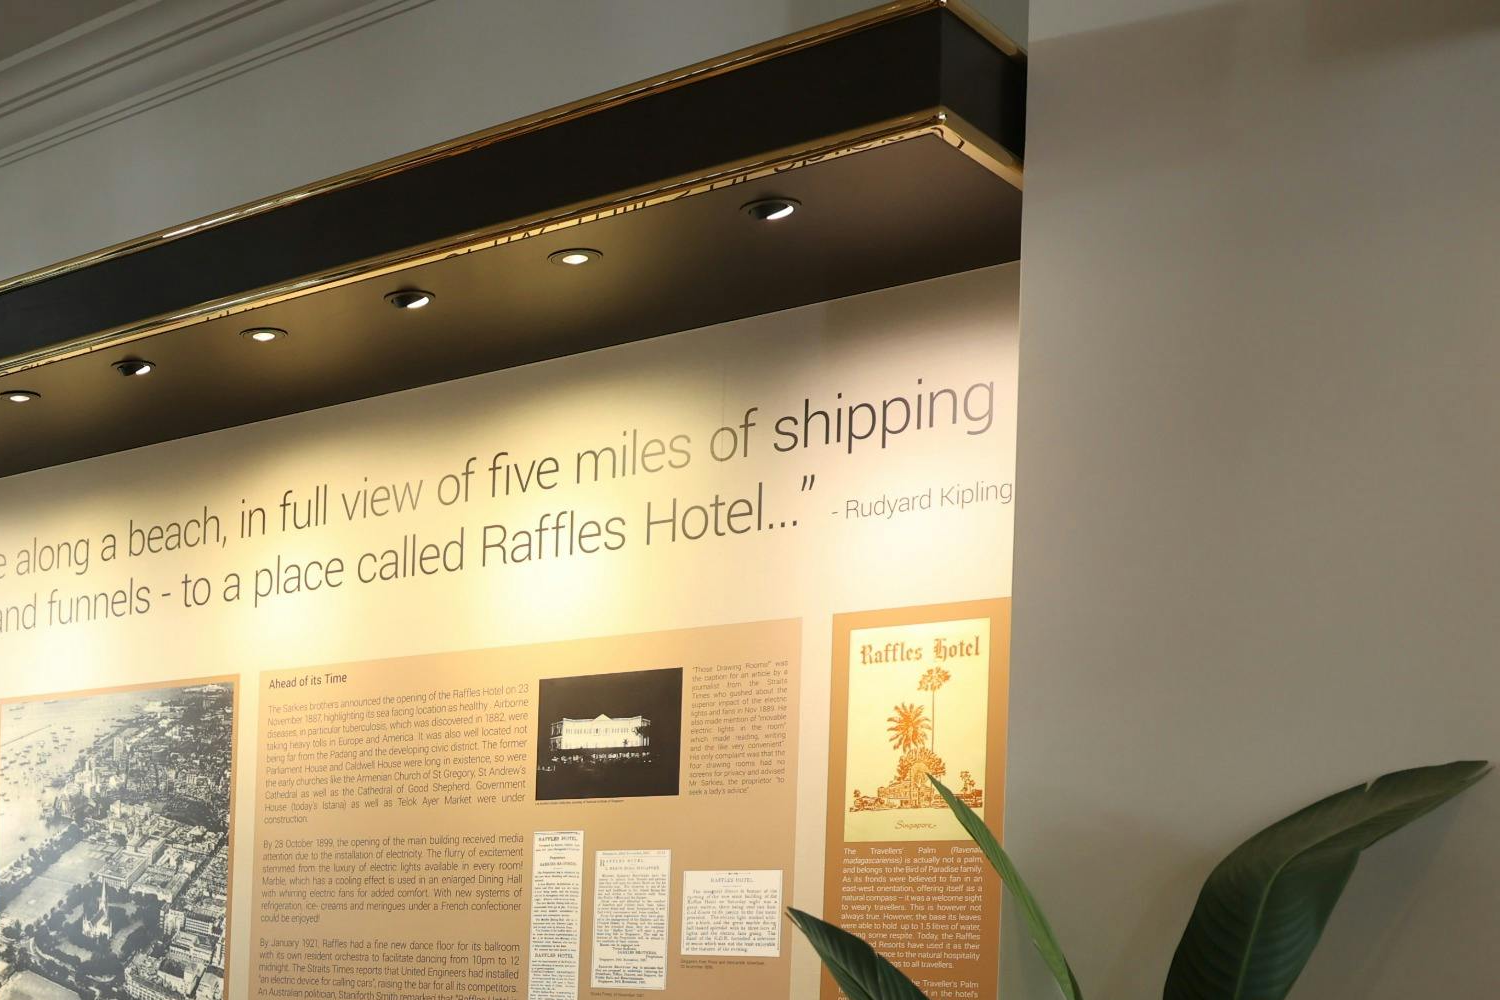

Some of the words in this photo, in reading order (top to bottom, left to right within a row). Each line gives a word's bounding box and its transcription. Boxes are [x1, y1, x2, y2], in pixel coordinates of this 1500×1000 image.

[16, 537, 90, 576] along
[101, 534, 116, 562] a
[129, 505, 227, 556] beach,
[241, 499, 266, 539] in
[280, 484, 328, 531] full
[342, 477, 424, 520] view
[438, 457, 477, 506] of
[488, 452, 559, 498] five
[577, 429, 692, 484] miles
[710, 407, 758, 462] of
[774, 379, 994, 454] shipping
[846, 488, 932, 520] Rudyard
[940, 481, 1013, 508] Kipling
[48, 577, 151, 626] funnels
[181, 573, 211, 608] to
[223, 572, 240, 602] a
[254, 554, 345, 608] place
[358, 526, 465, 584] called
[482, 510, 626, 567] Raffles
[860, 643, 923, 666] Raffles
[933, 636, 981, 663] Hotel
[269, 676, 296, 688] Ahead
[299, 675, 308, 686] of
[311, 675, 322, 685] its
[325, 673, 347, 683] Time
[263, 840, 272, 850] By
[285, 839, 313, 847] October
[337, 838, 348, 846] the
[350, 837, 379, 848] opening
[382, 837, 389, 845] of
[392, 836, 404, 845] the
[407, 836, 426, 844] main
[429, 835, 459, 846] building
[462, 834, 495, 843] received
[498, 833, 523, 842] media
[262, 864, 295, 872] stemmed
[318, 863, 330, 871] the
[333, 863, 355, 873] luxury
[359, 863, 366, 871] of
[370, 862, 396, 871] electric
[400, 862, 420, 873] lights
[424, 861, 458, 870] available
[462, 861, 469, 870] in
[473, 863, 494, 872] every
[913, 857, 939, 865] actually
[856, 866, 882, 874] belongs
[259, 950, 273, 958] with
[276, 951, 284, 959] its
[305, 951, 332, 960] resident
[334, 952, 369, 961] orchestra
[371, 953, 379, 961] to
[382, 953, 413, 962] facilitate
[416, 954, 446, 965] dancing
[450, 954, 468, 963] from
[472, 955, 494, 966] 10pm
[498, 955, 506, 964] to
[511, 956, 519, 964] 12
